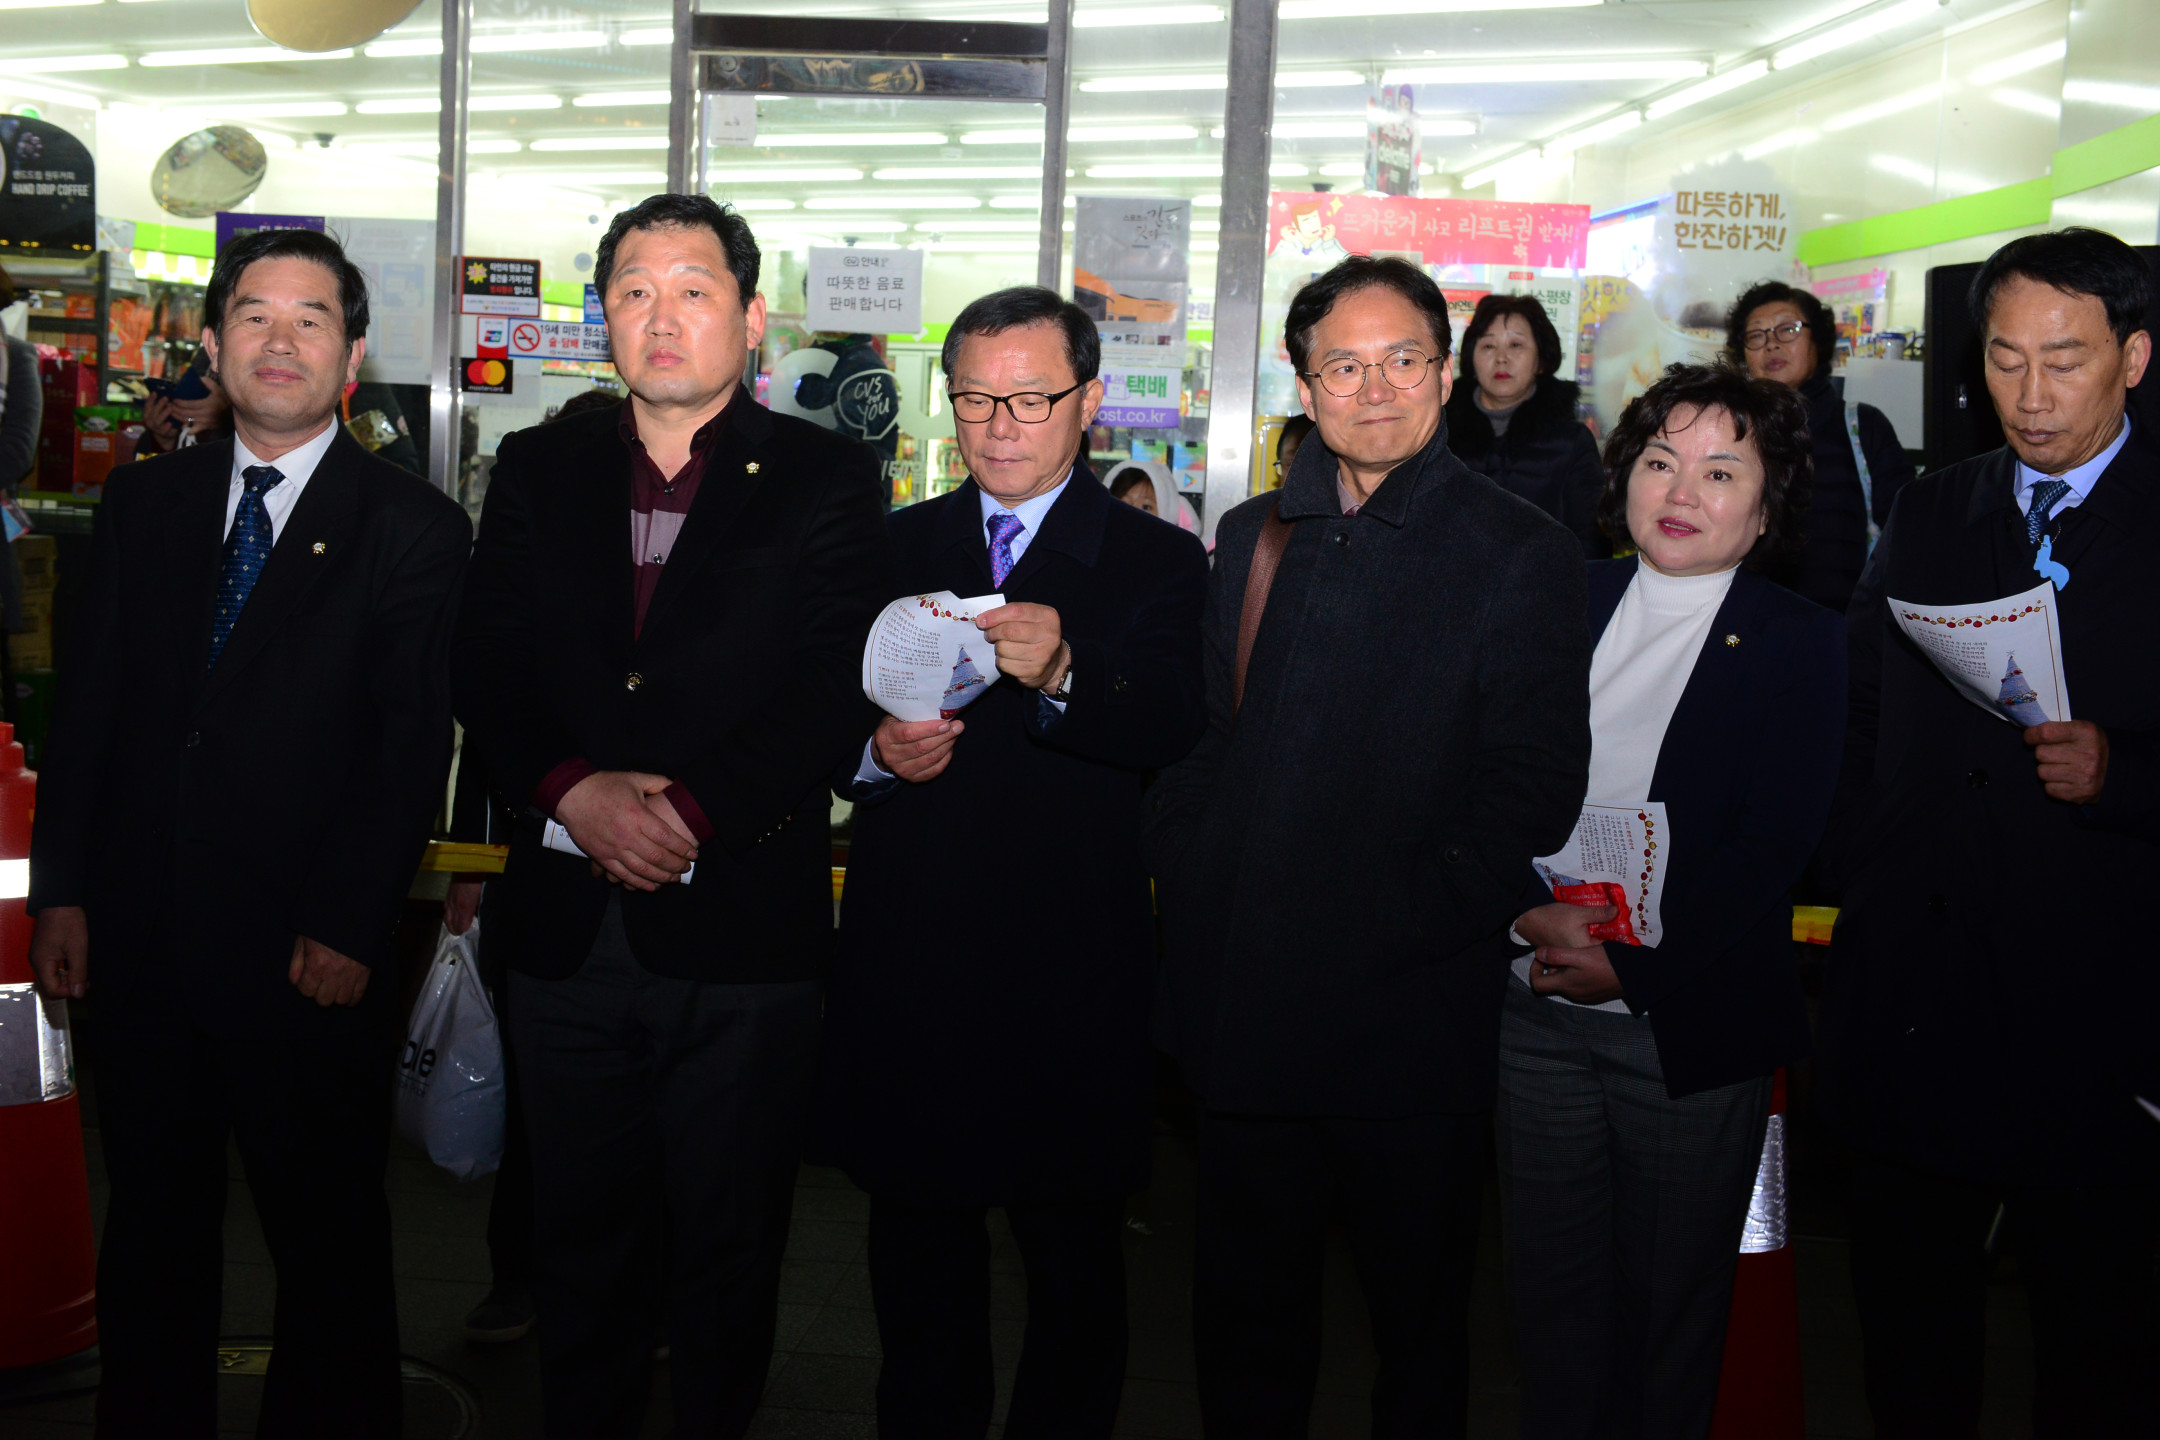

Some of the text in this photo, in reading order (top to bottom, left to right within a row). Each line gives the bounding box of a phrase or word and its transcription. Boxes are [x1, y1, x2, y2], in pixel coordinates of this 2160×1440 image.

[11, 183, 89, 196] HAND DRIP COFFEE
[1676, 191, 1786, 220] 따뜻하게,
[1341, 208, 1574, 243] 뜨거운거 사고 리프트권 받자!
[1674, 221, 1787, 251] 한잔하겟!
[861, 256, 879, 267] 안내
[827, 275, 905, 291] 따뜻한 음료
[829, 297, 902, 311] 판매합니다
[540, 324, 559, 336] 19세
[562, 325, 580, 337] 미만
[854, 375, 883, 400] CVS
[1126, 375, 1168, 398] 택배
[857, 397, 890, 425] YOU
[1095, 408, 1166, 423] ost.co.kr
